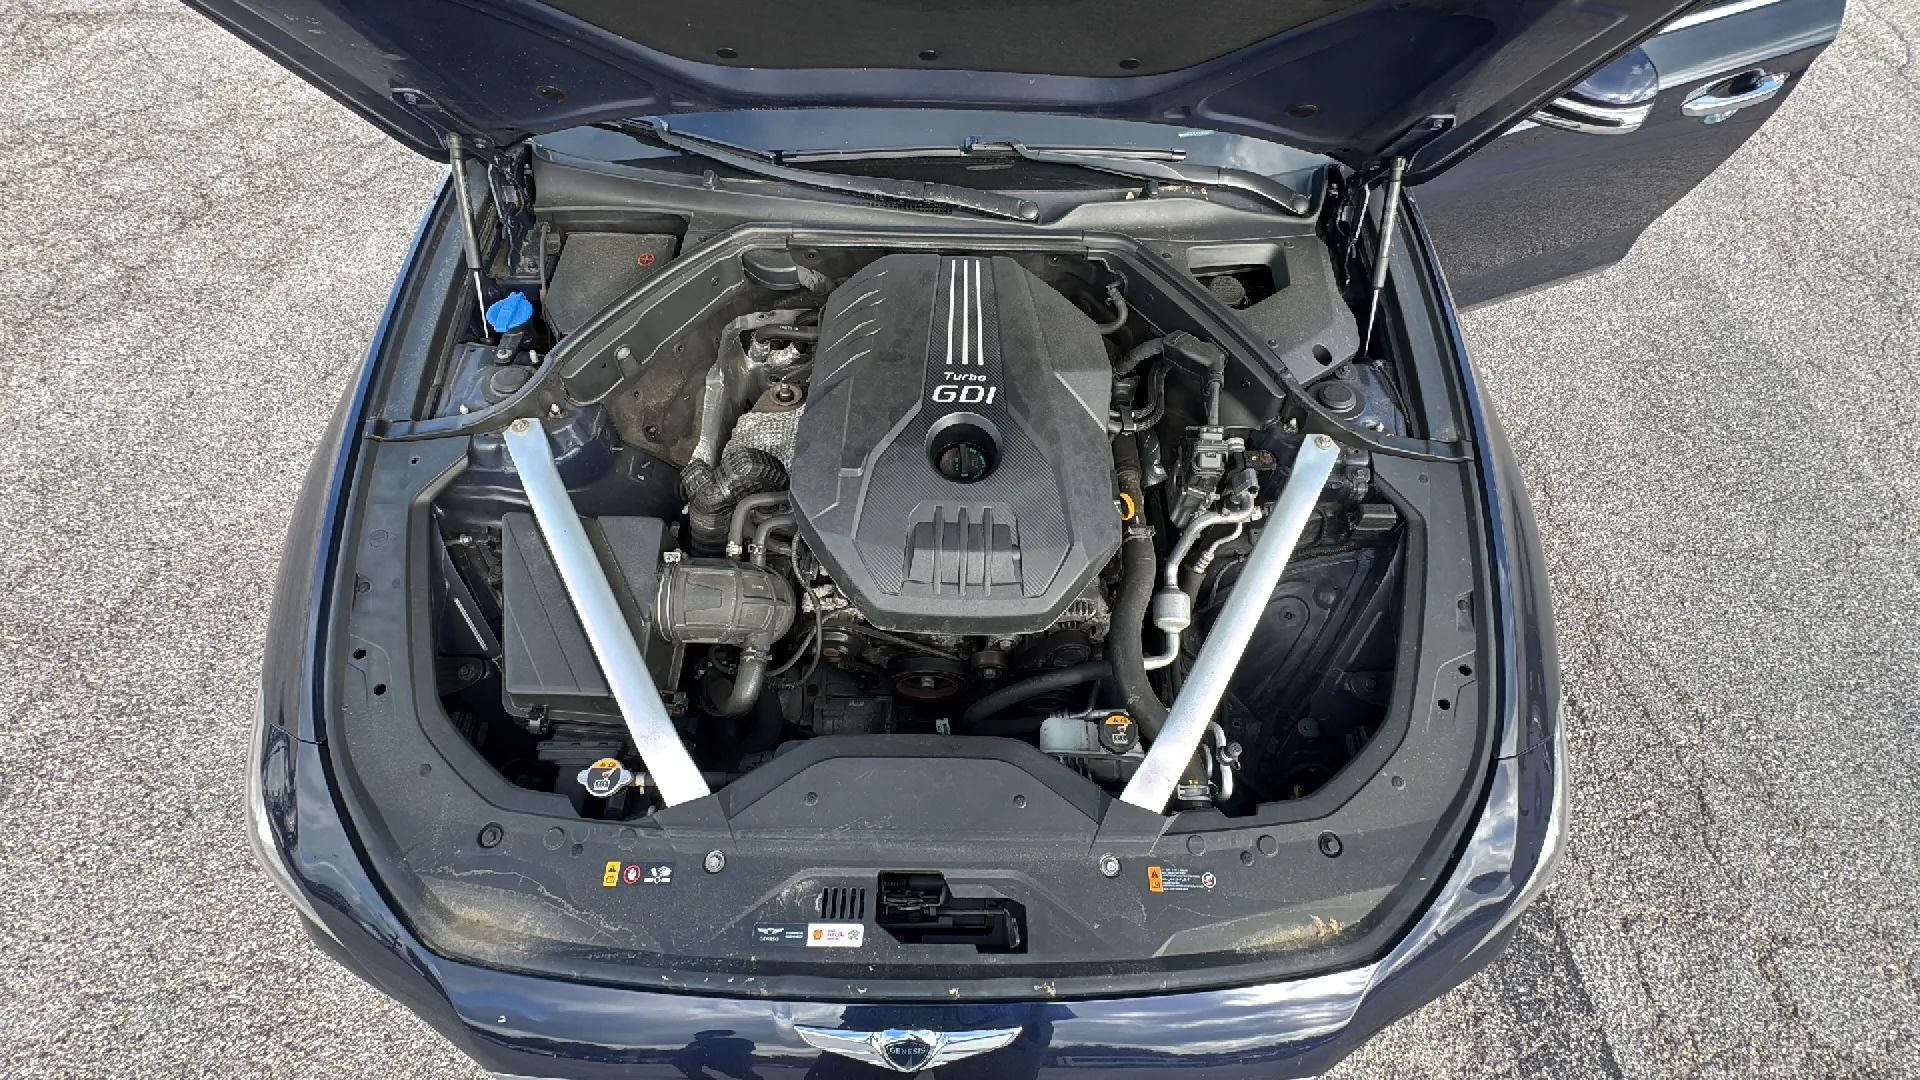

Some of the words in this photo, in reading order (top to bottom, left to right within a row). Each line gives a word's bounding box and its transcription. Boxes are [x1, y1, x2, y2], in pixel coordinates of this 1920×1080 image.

[943, 371, 987, 381] Turbo
[932, 385, 997, 404] GDI
[889, 1047, 926, 1055] GENESIS
